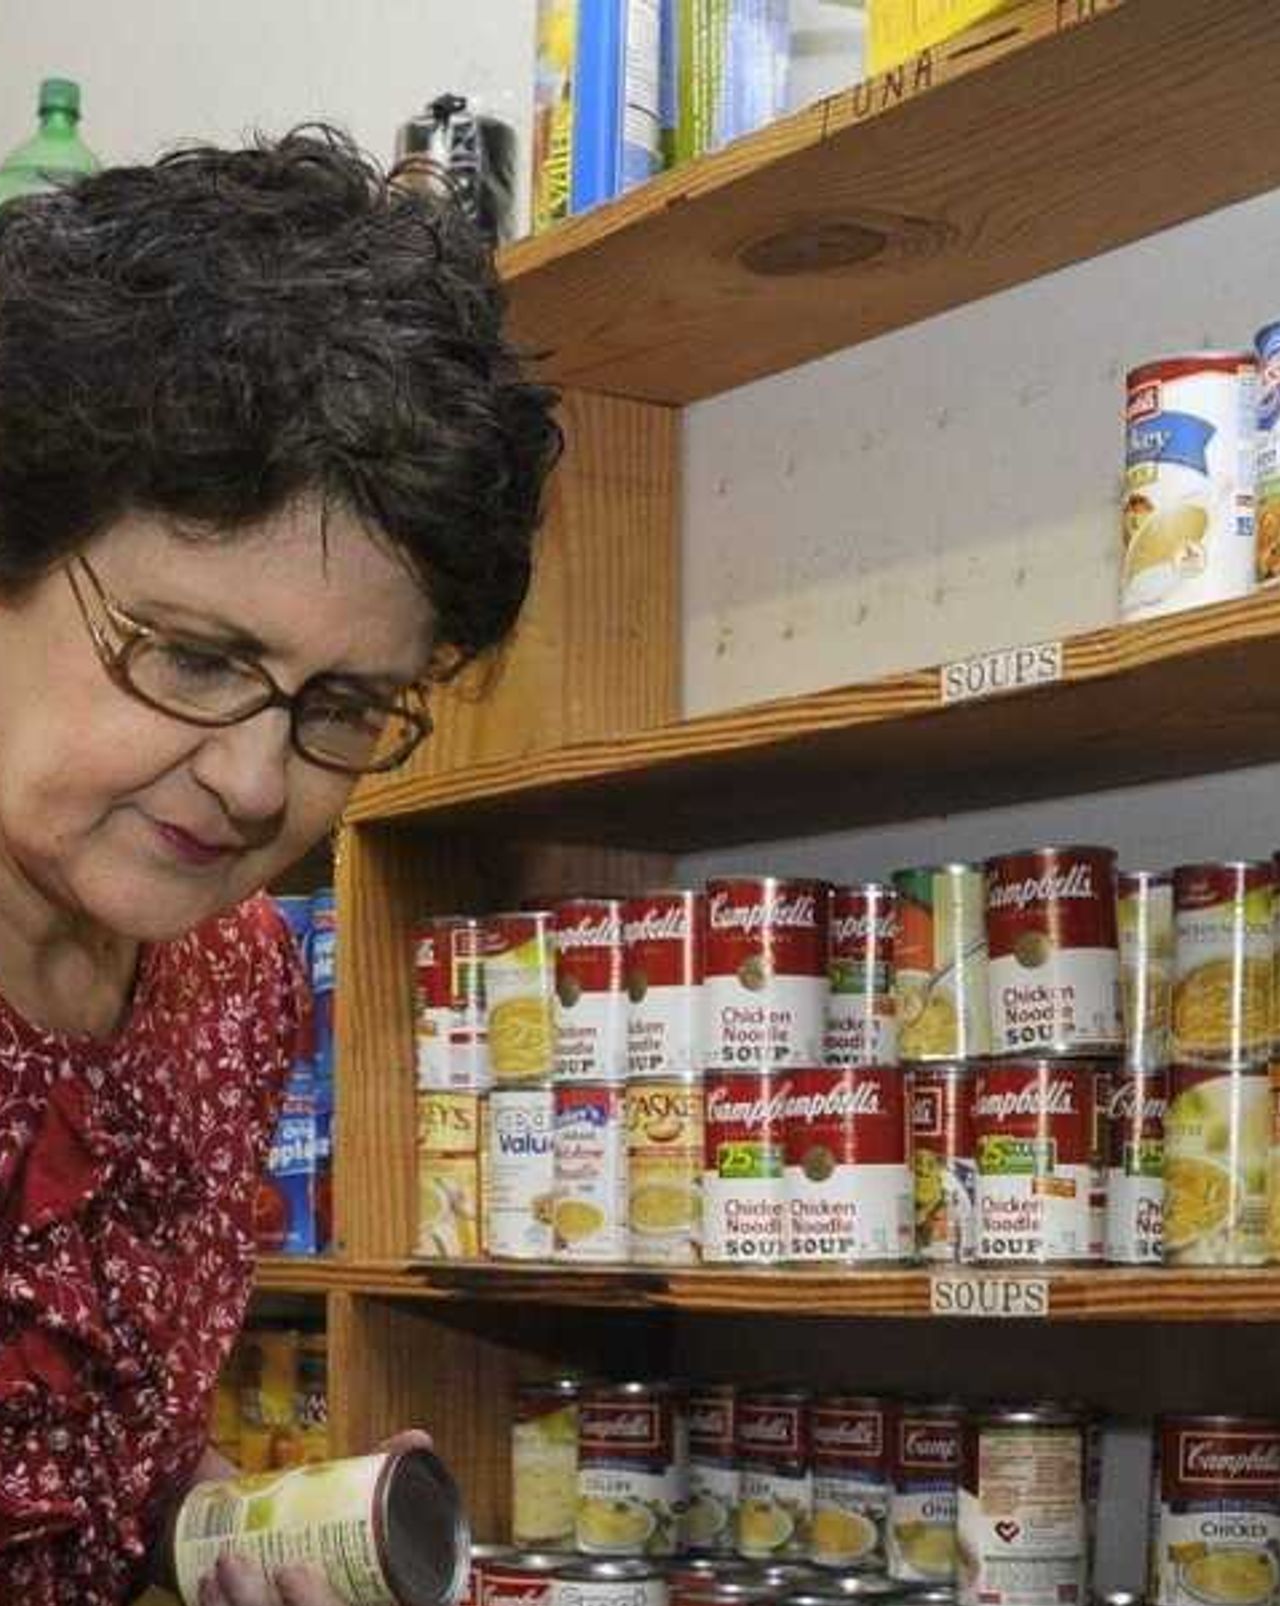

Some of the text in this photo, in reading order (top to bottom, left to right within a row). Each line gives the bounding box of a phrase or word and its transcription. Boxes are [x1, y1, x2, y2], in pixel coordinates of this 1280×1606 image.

[817, 46, 933, 143] TUNA
[948, 648, 1057, 697] SOUPS
[790, 1237, 856, 1255] SOUP
[933, 1281, 1045, 1313] SOUPS
